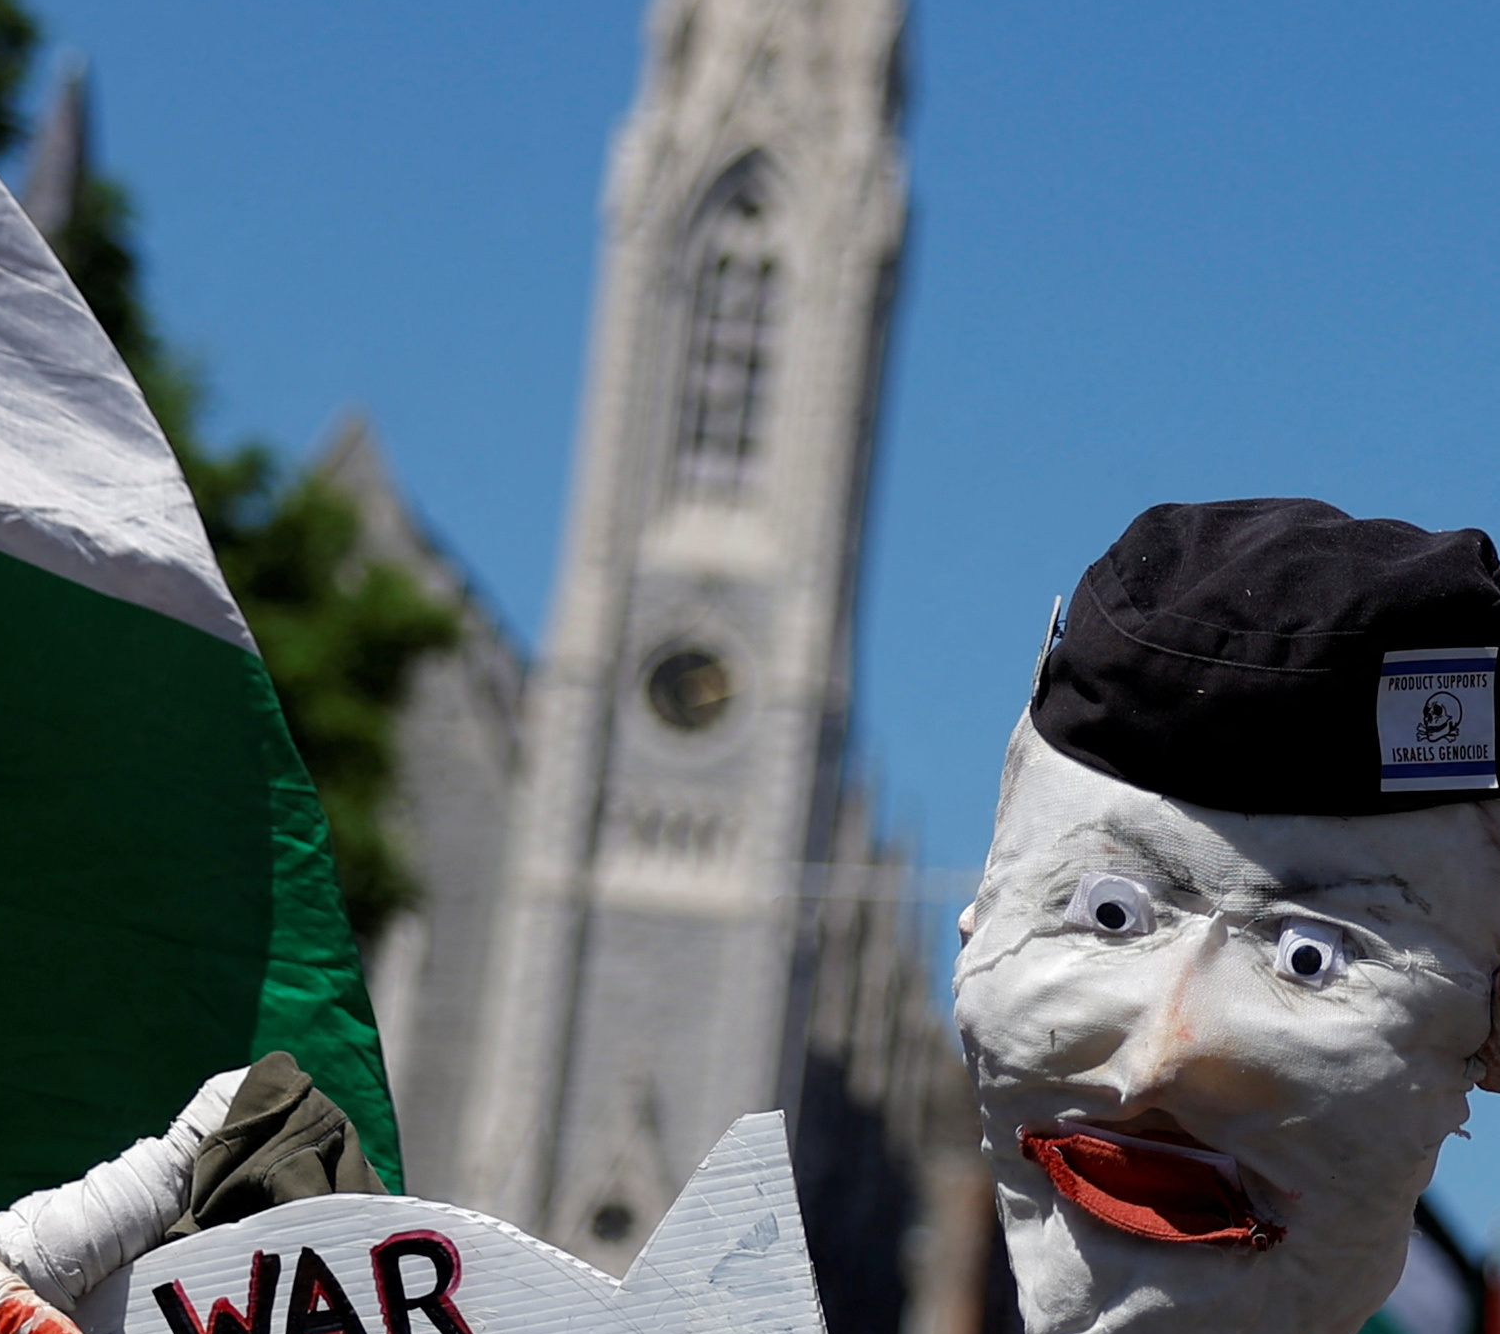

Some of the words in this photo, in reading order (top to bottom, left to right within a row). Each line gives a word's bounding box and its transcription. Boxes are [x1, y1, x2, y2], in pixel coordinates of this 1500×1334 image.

[1387, 676, 1434, 692] PRODUCT
[1436, 673, 1488, 690] SUPPORTS
[1392, 746, 1435, 763] ISRAELS
[1438, 744, 1489, 761] GENOCIDE
